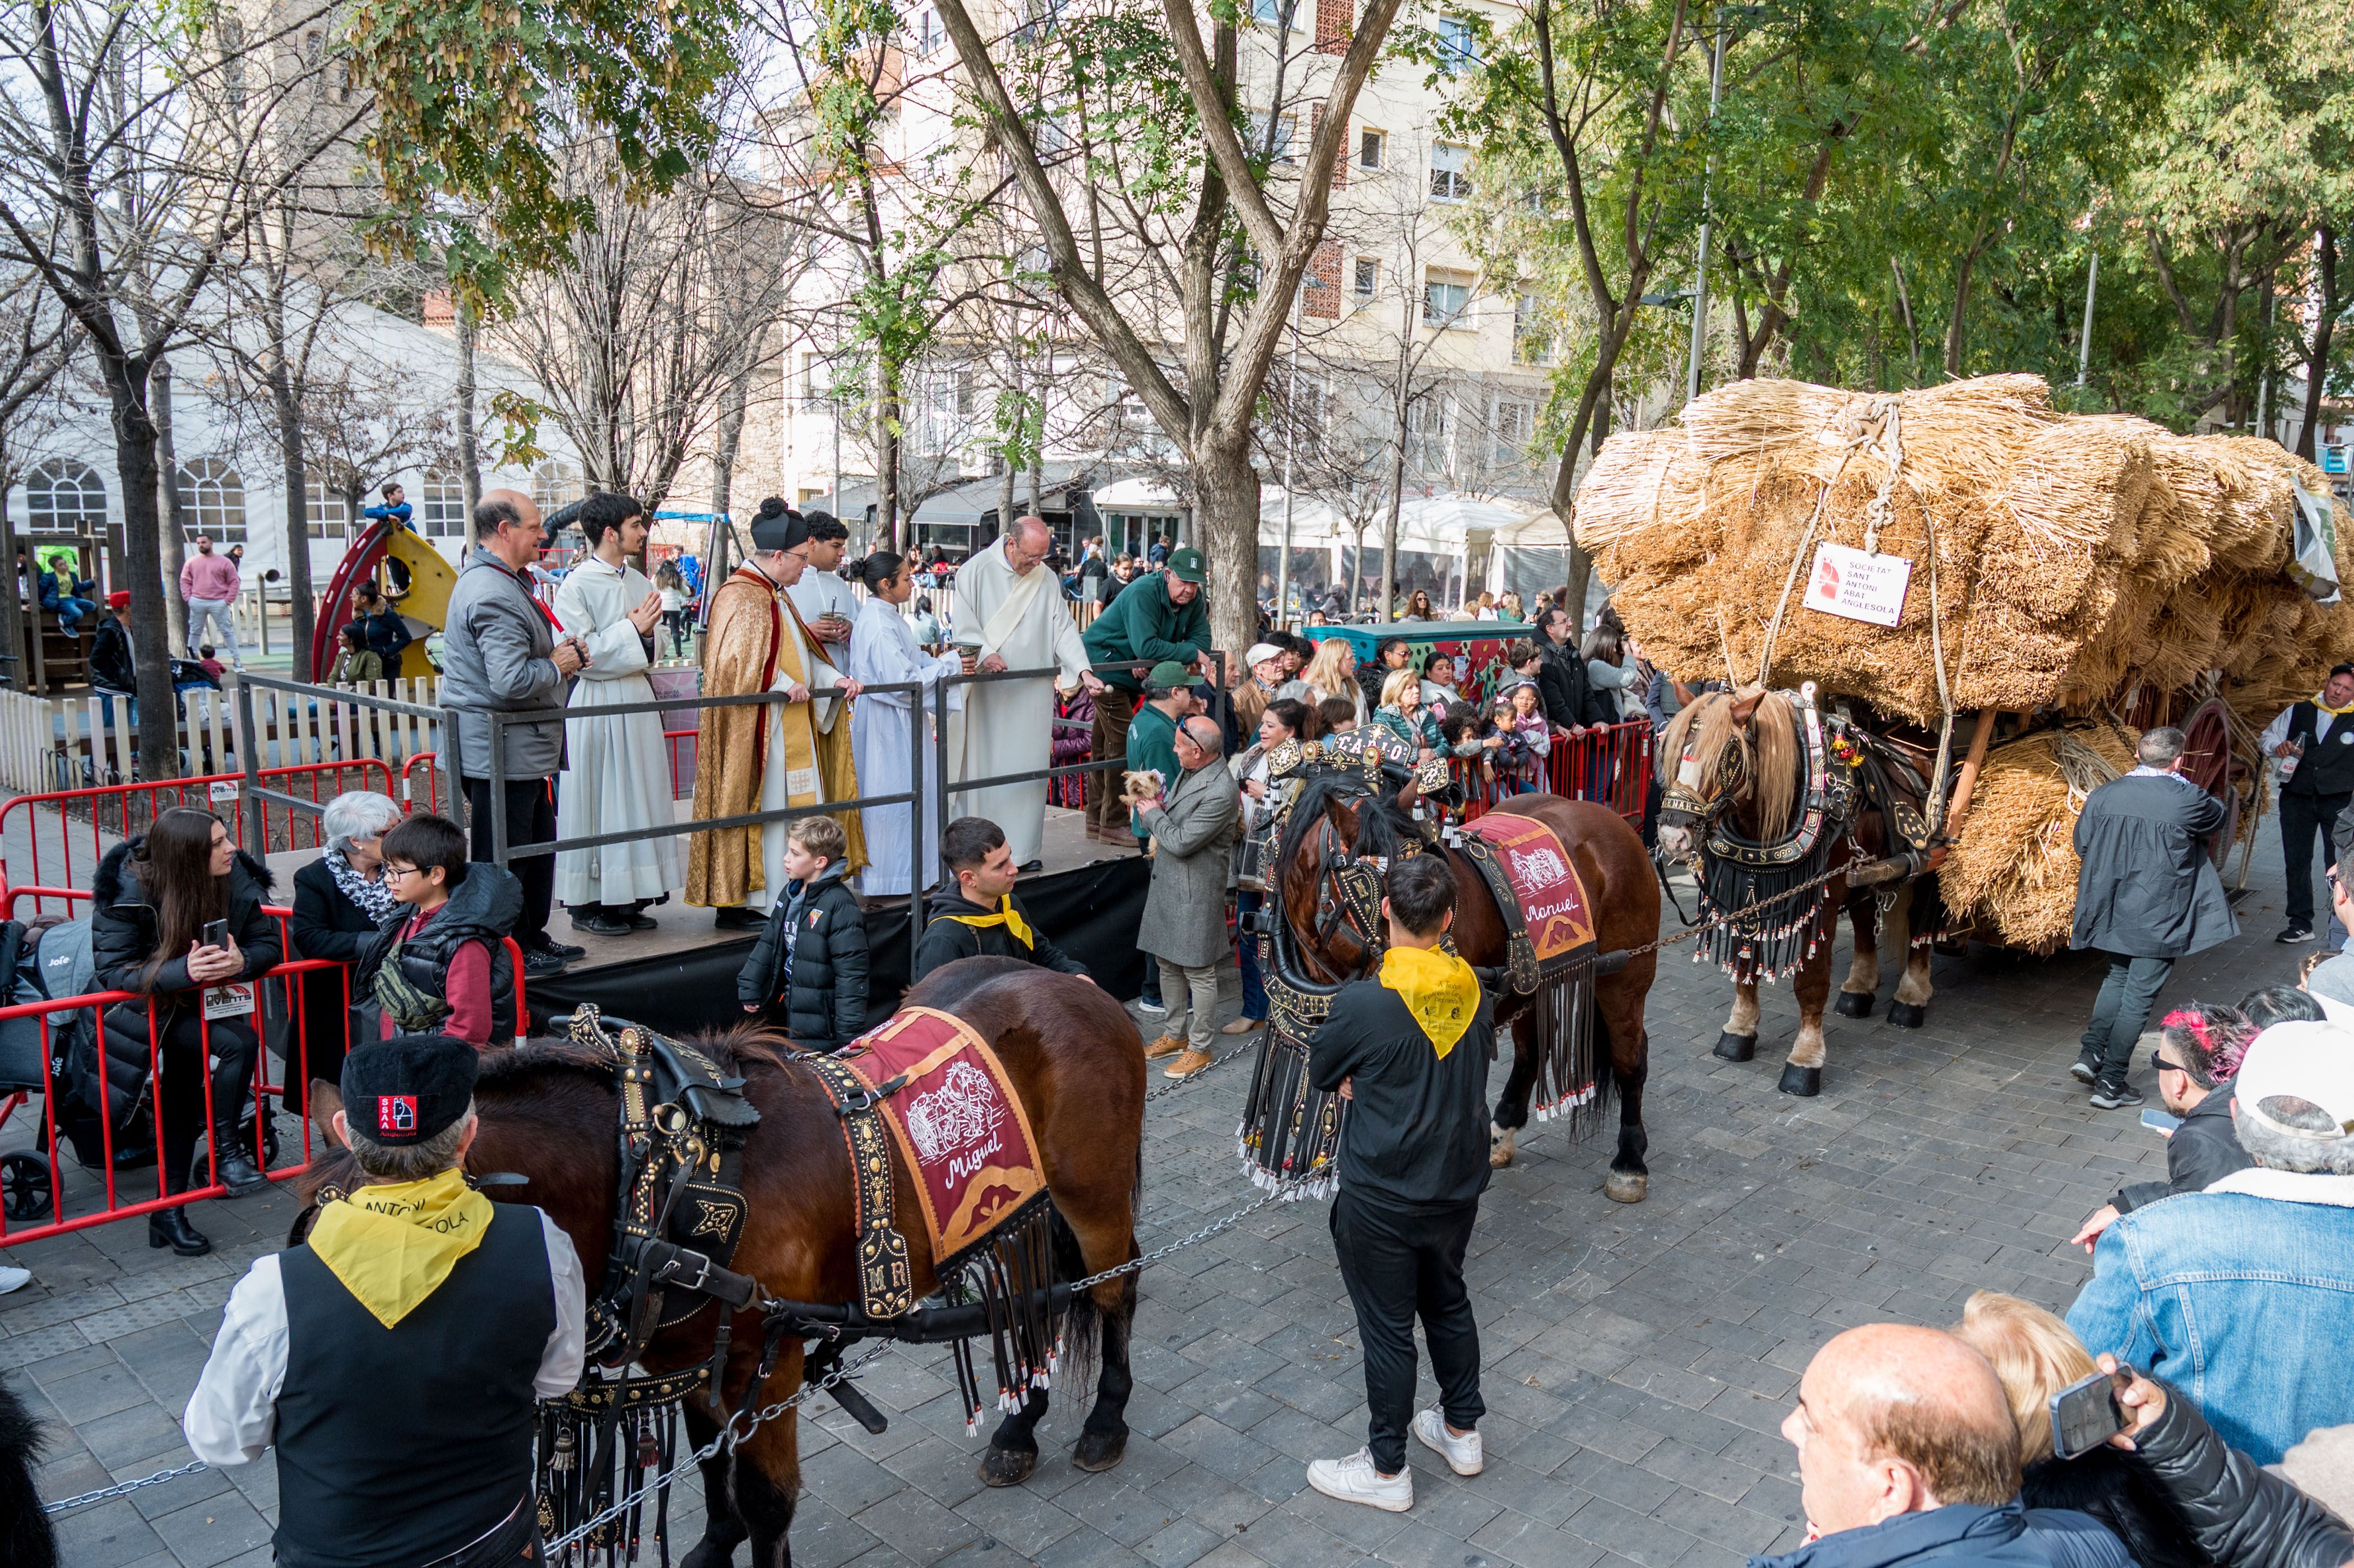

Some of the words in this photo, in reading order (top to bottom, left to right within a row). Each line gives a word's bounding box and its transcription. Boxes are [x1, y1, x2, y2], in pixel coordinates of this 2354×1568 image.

[1849, 562, 1892, 574] SOCIETAT
[1847, 571, 1870, 581] SANT
[1846, 580, 1878, 592] ANTONI
[1844, 589, 1865, 599] ABAT
[1841, 598, 1894, 614] ANGLESOLA
[1525, 893, 1579, 922] Manuel
[946, 1130, 1003, 1189] Miguel
[425, 1212, 469, 1233] OLA
